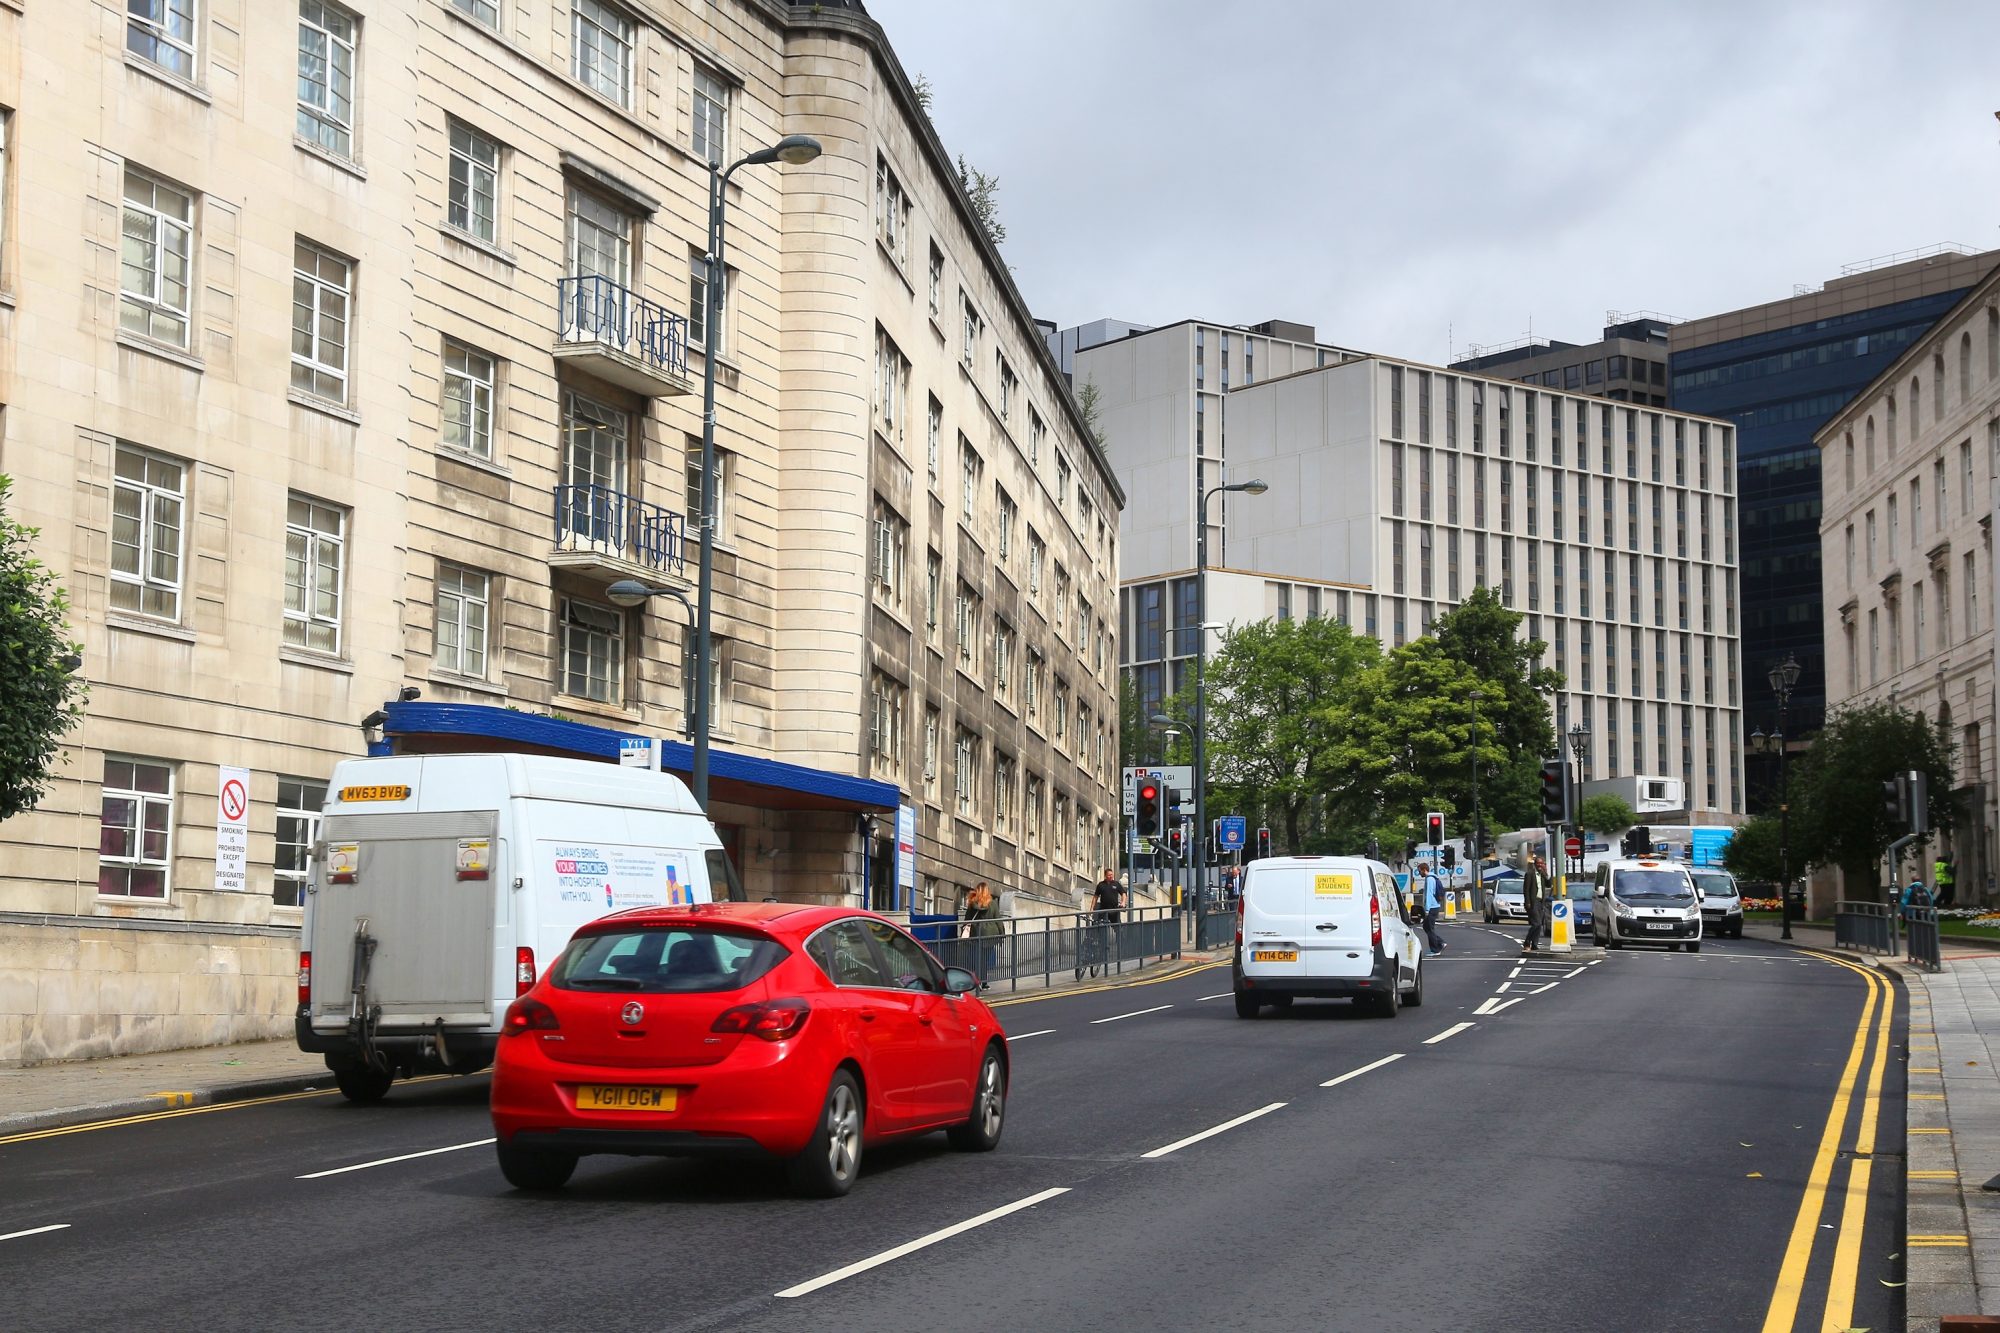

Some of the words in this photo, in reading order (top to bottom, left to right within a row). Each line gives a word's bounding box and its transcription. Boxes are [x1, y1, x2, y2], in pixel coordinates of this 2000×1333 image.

[627, 740, 644, 748] Y11
[379, 786, 402, 798] BVB
[221, 826, 244, 836] SMOKING
[218, 844, 245, 853] PROHIBITED
[556, 847, 581, 858] ALWAYS
[581, 849, 599, 859] BRING
[222, 853, 240, 861] EXCEPT
[557, 861, 576, 872] YOUR
[576, 862, 607, 874] MEDICINES
[216, 870, 245, 880] DESIGNATED
[222, 880, 239, 888] AREAS
[559, 876, 573, 887] INTO
[574, 877, 604, 888] HOSPITAL
[560, 890, 577, 901] WITH
[1258, 951, 1276, 960] YT14
[1277, 951, 1294, 960] CRF
[592, 1087, 623, 1105] YG11
